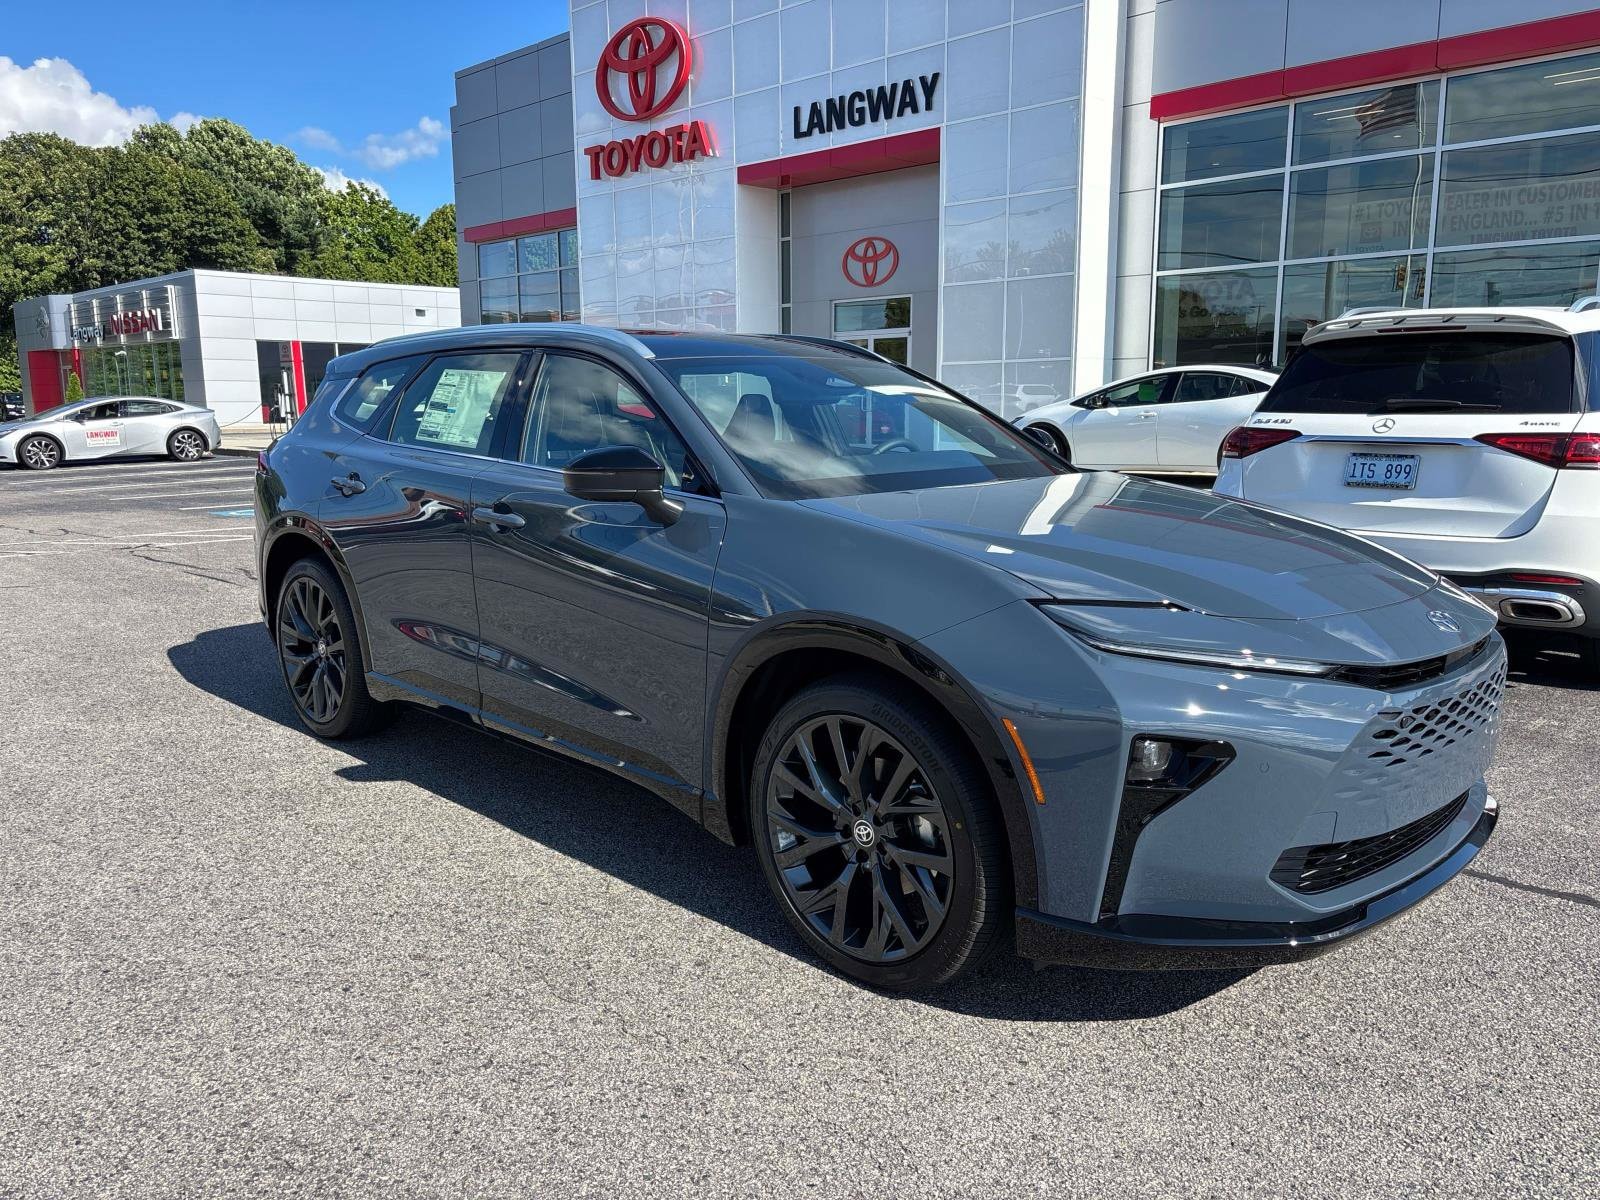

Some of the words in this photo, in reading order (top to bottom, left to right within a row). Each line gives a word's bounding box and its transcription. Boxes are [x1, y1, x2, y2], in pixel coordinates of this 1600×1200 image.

[793, 72, 941, 139] LANGWAY
[585, 120, 710, 181] TOYOTA
[1377, 199, 1431, 218] TOYOA
[1444, 189, 1491, 211] EALER
[1495, 189, 1512, 207] IN
[1517, 181, 1600, 206] CUSTOMER
[1392, 221, 1408, 237] IN
[1543, 205, 1564, 224] #5
[1570, 203, 1588, 222] IN
[70, 325, 105, 342] Langway
[110, 308, 162, 336] NISSAN
[86, 430, 118, 439] LANGWAY
[1384, 463, 1412, 480] 899
[871, 703, 945, 775] BRIDGESTONE
